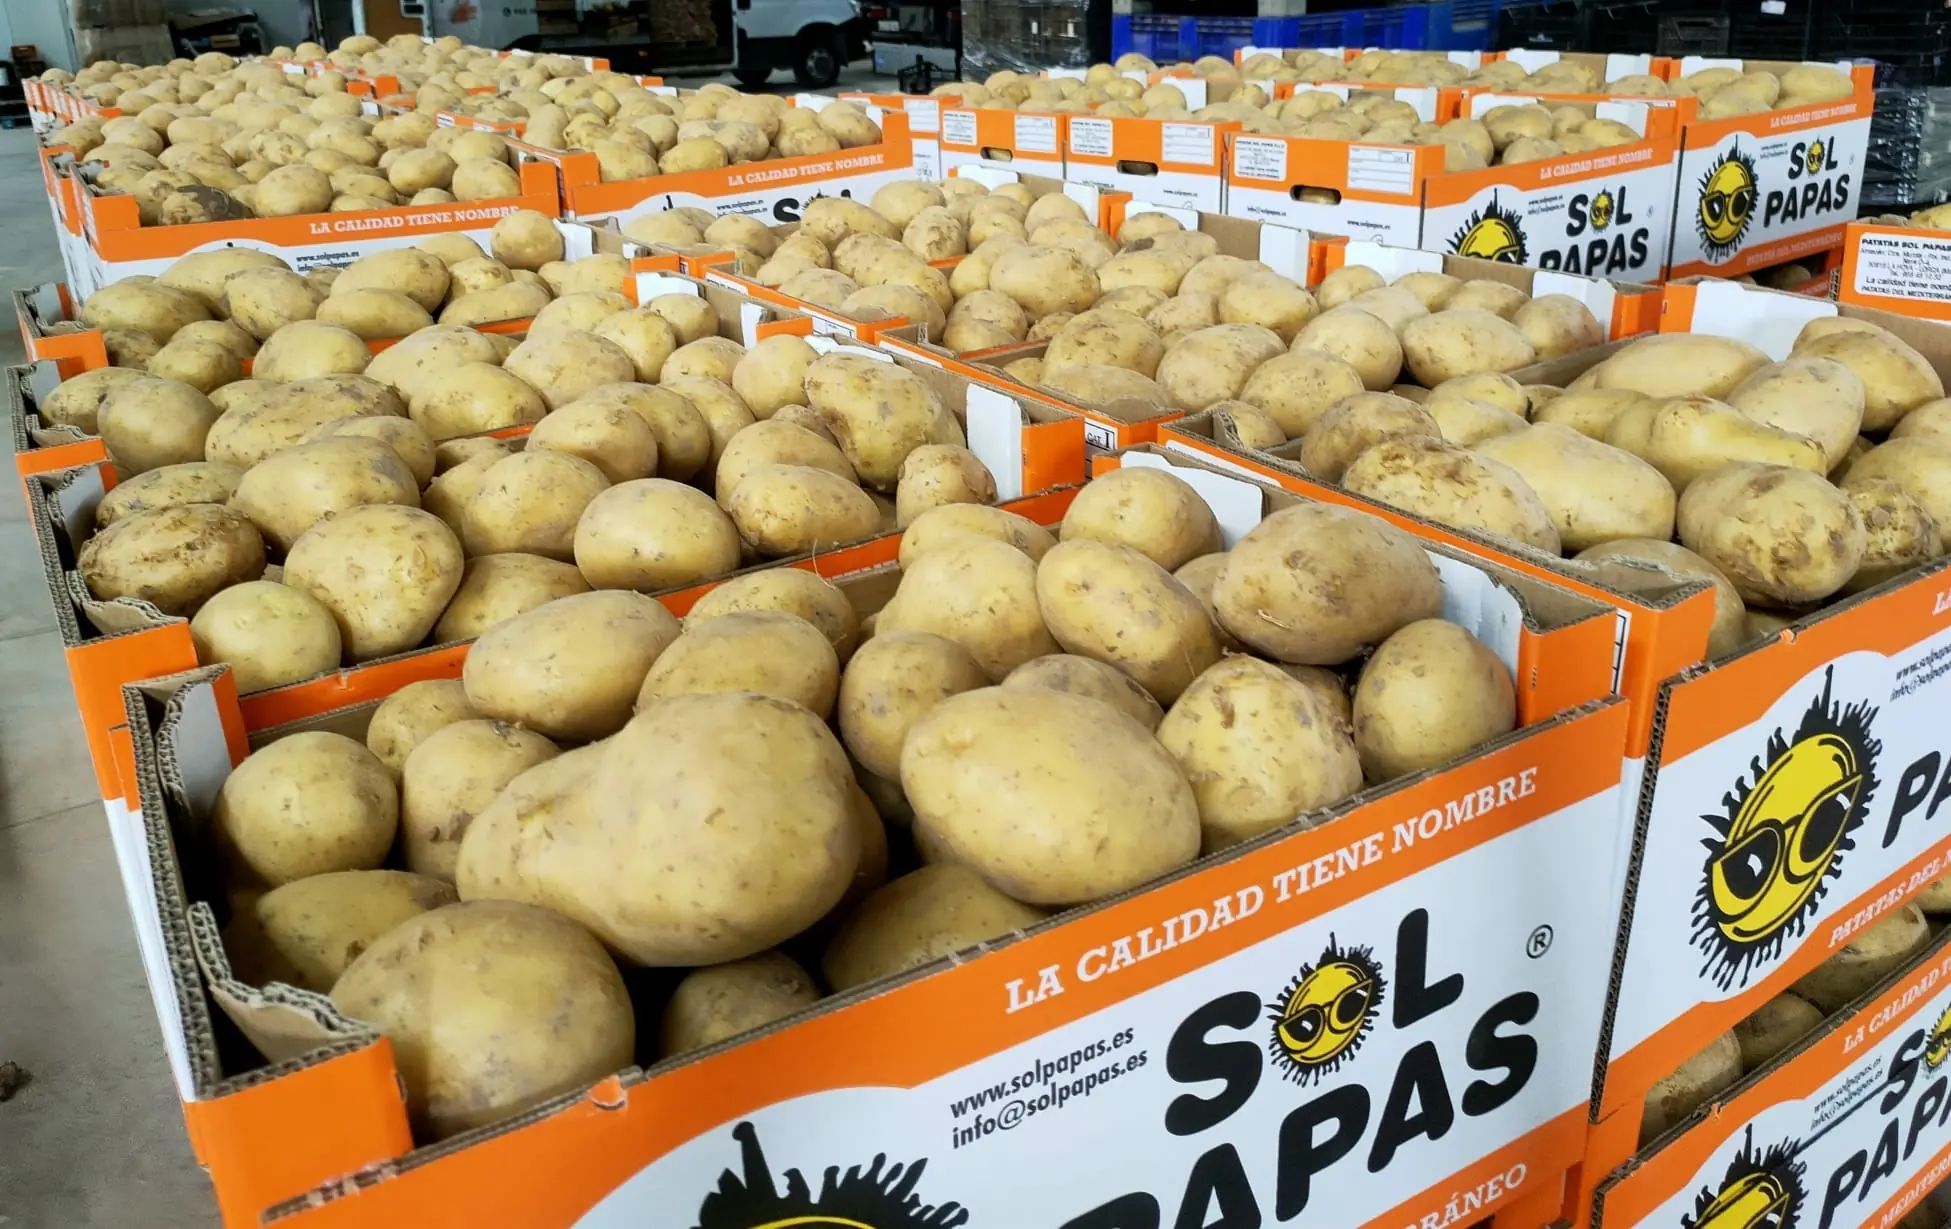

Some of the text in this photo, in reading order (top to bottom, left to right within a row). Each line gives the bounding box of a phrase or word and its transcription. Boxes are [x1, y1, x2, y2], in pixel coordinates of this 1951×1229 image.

[728, 154, 884, 187] LA CALIDAD TIENE NOMBRE
[1763, 174, 1850, 228] PAPAS
[310, 222, 330, 235] LA
[334, 216, 404, 232] CALIDAD
[405, 211, 452, 227] TIENE
[1566, 184, 1632, 237] SOL
[1861, 239, 1899, 248] PATATAS
[1902, 242, 1918, 250] SOL
[1005, 766, 1539, 1015] LA CALIDAD TIENE NOMBRE
[1828, 882, 1908, 949] PATATAS
[1906, 857, 1941, 894] DEL
[1165, 907, 1465, 1137] SOL
[1842, 968, 1940, 1055] LA CALIDAD
[950, 1024, 1135, 1119] www.solpapas.es
[951, 1048, 1148, 1150] info@solpapas.es
[1402, 1163, 1528, 1229] RÁNEO
